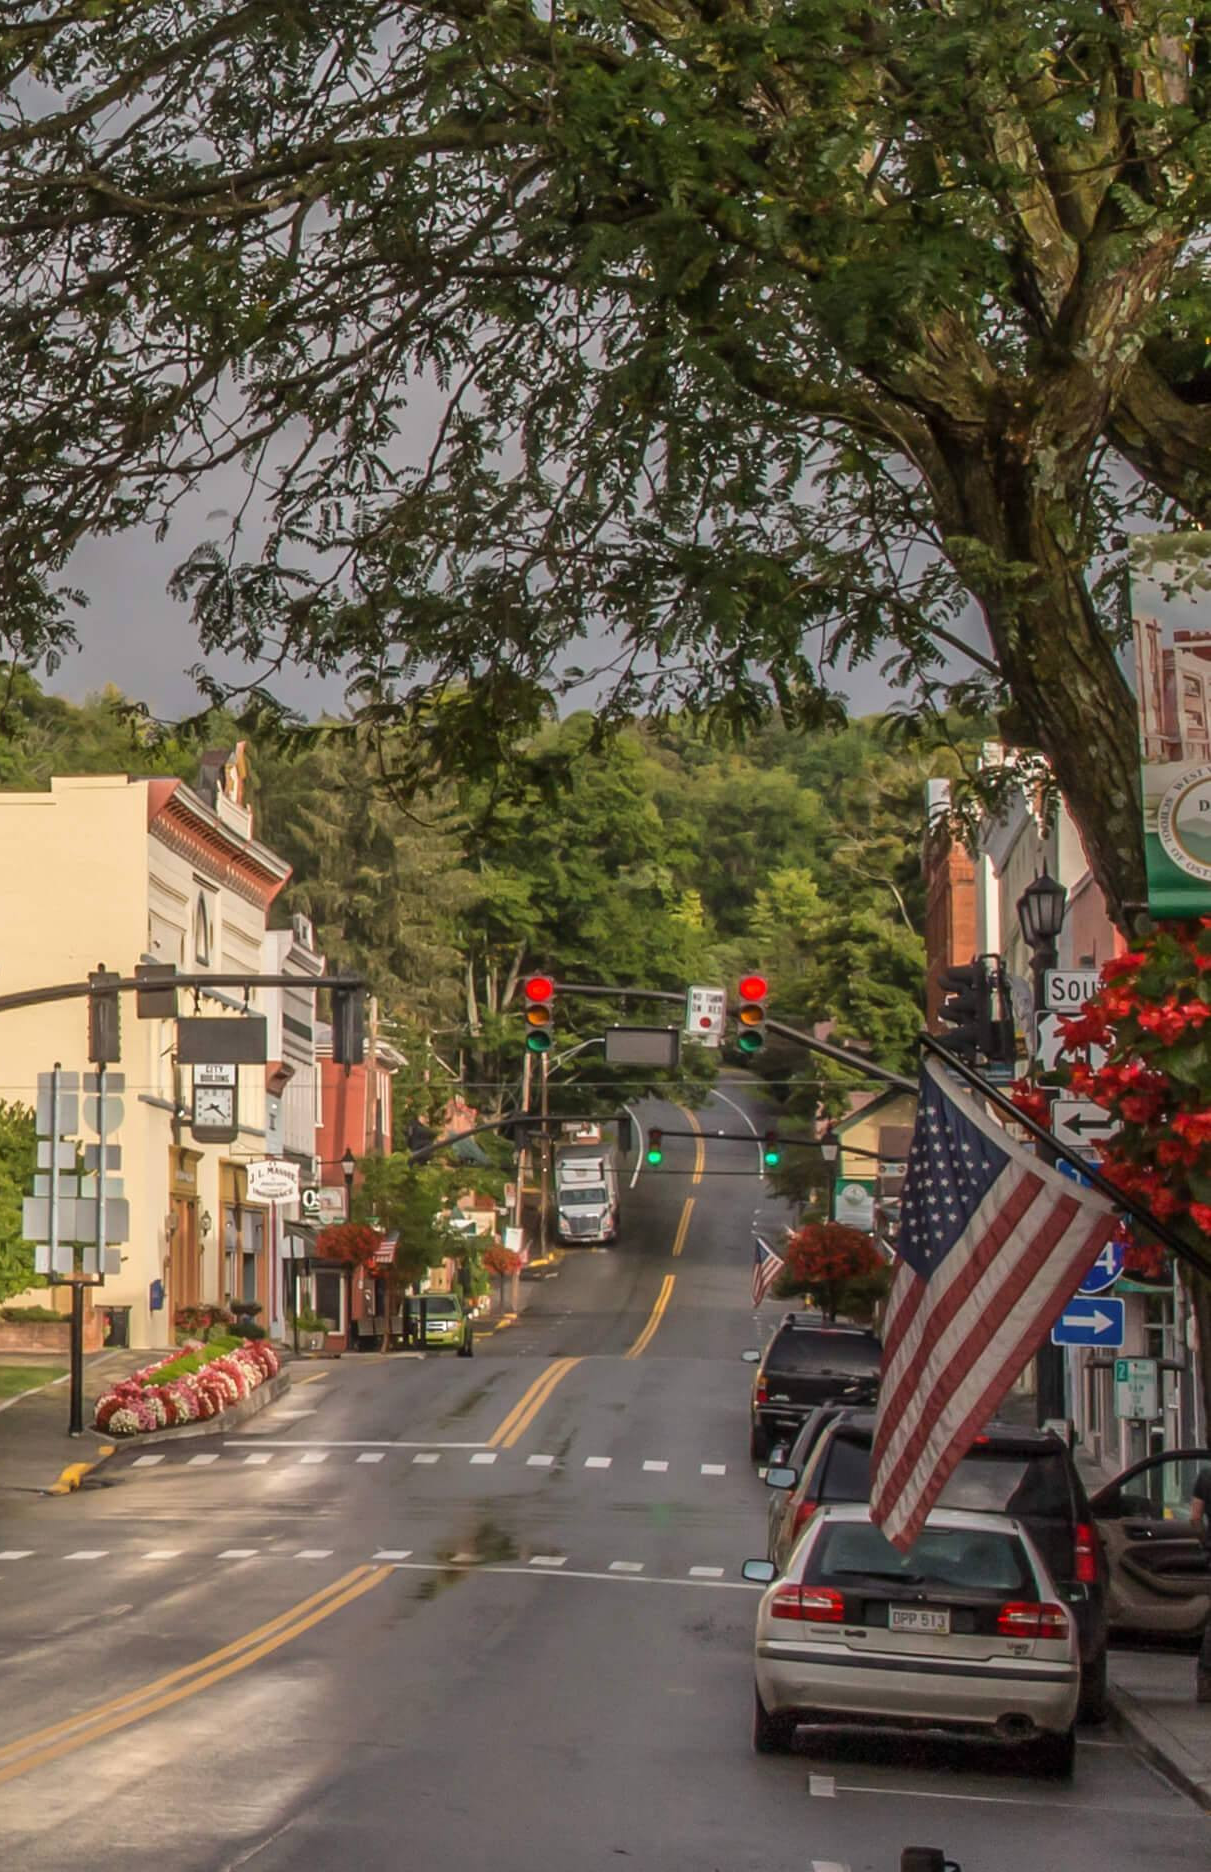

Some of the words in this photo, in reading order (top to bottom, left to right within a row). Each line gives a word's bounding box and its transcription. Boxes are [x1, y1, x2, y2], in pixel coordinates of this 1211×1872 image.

[1173, 768, 1203, 791] WEST
[1052, 977, 1097, 1001] SOU
[1093, 1241, 1117, 1275] 4
